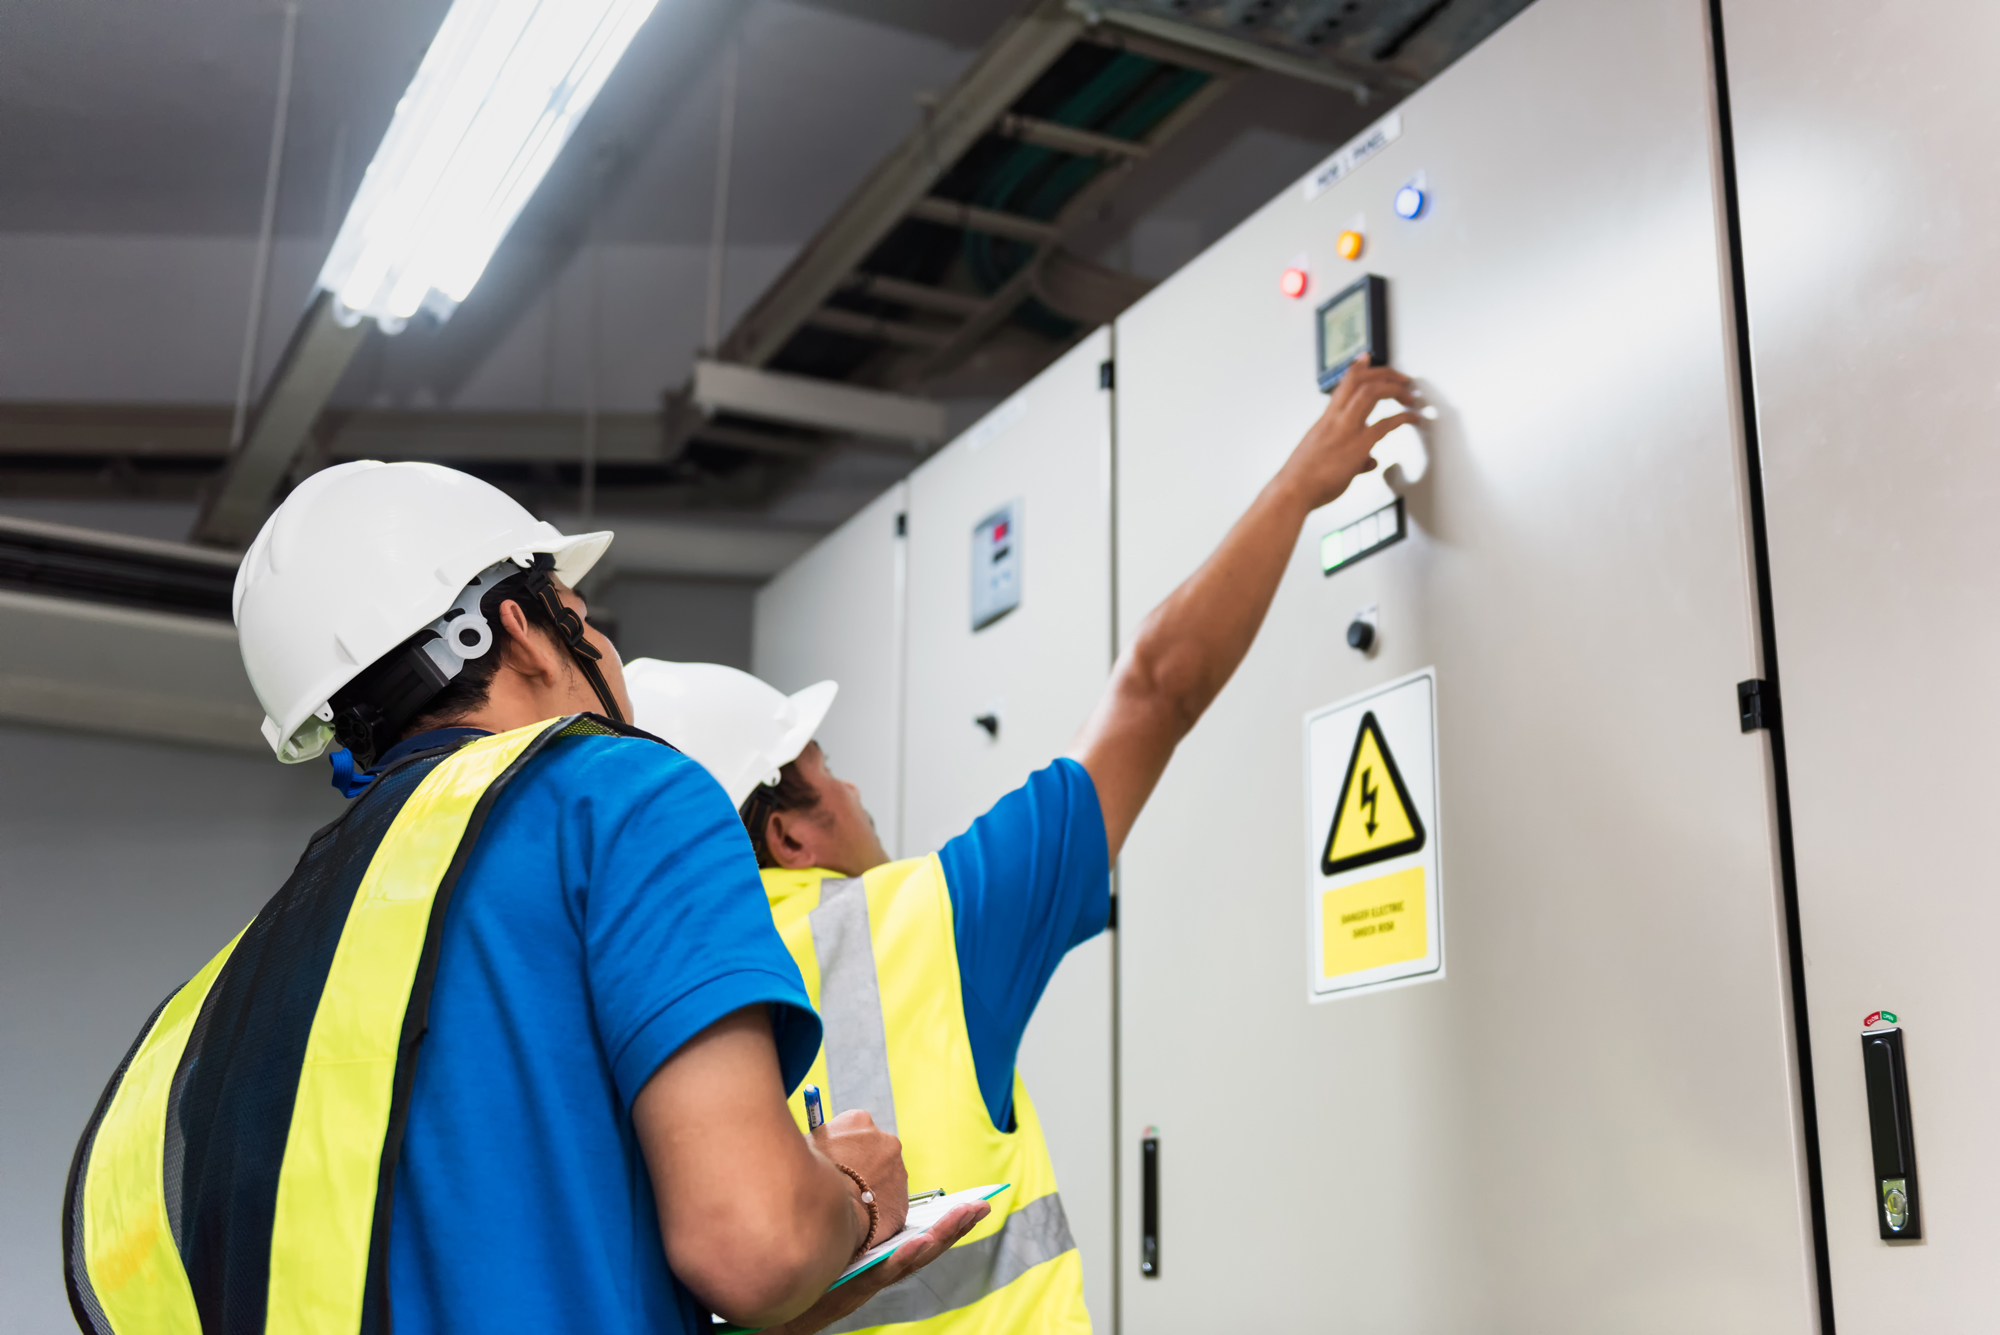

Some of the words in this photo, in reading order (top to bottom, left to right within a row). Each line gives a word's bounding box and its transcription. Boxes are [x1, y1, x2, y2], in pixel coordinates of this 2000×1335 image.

[1341, 908, 1369, 924] DANGER
[1371, 900, 1404, 918] ELECTRIC
[1352, 925, 1376, 939] SHOCK
[1378, 921, 1395, 934] RISK
[1882, 1013, 1894, 1021] OPEN
